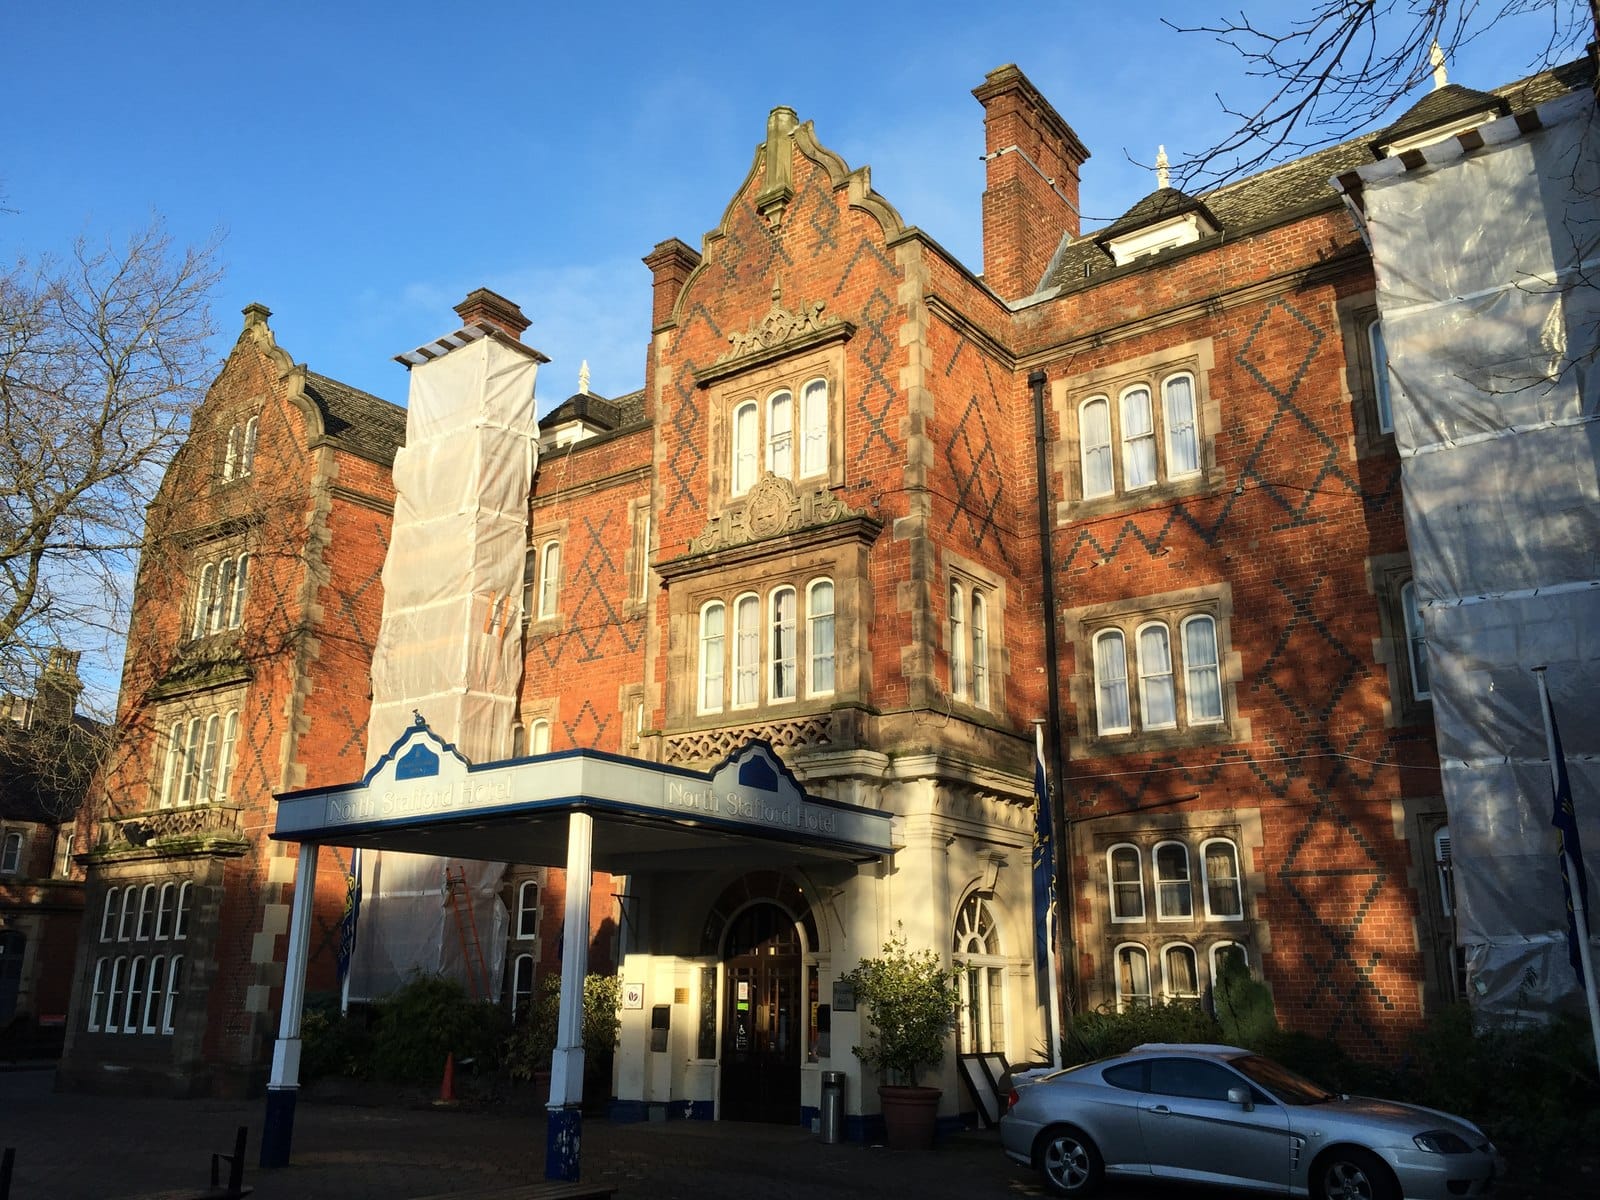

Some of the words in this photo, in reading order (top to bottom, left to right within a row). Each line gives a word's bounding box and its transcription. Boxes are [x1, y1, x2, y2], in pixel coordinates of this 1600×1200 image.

[328, 794, 375, 822] North
[383, 782, 453, 814] Stafford
[460, 774, 513, 804] Hotel
[669, 782, 719, 812] North
[726, 792, 791, 824] Stafford
[797, 806, 836, 833] Hotel
